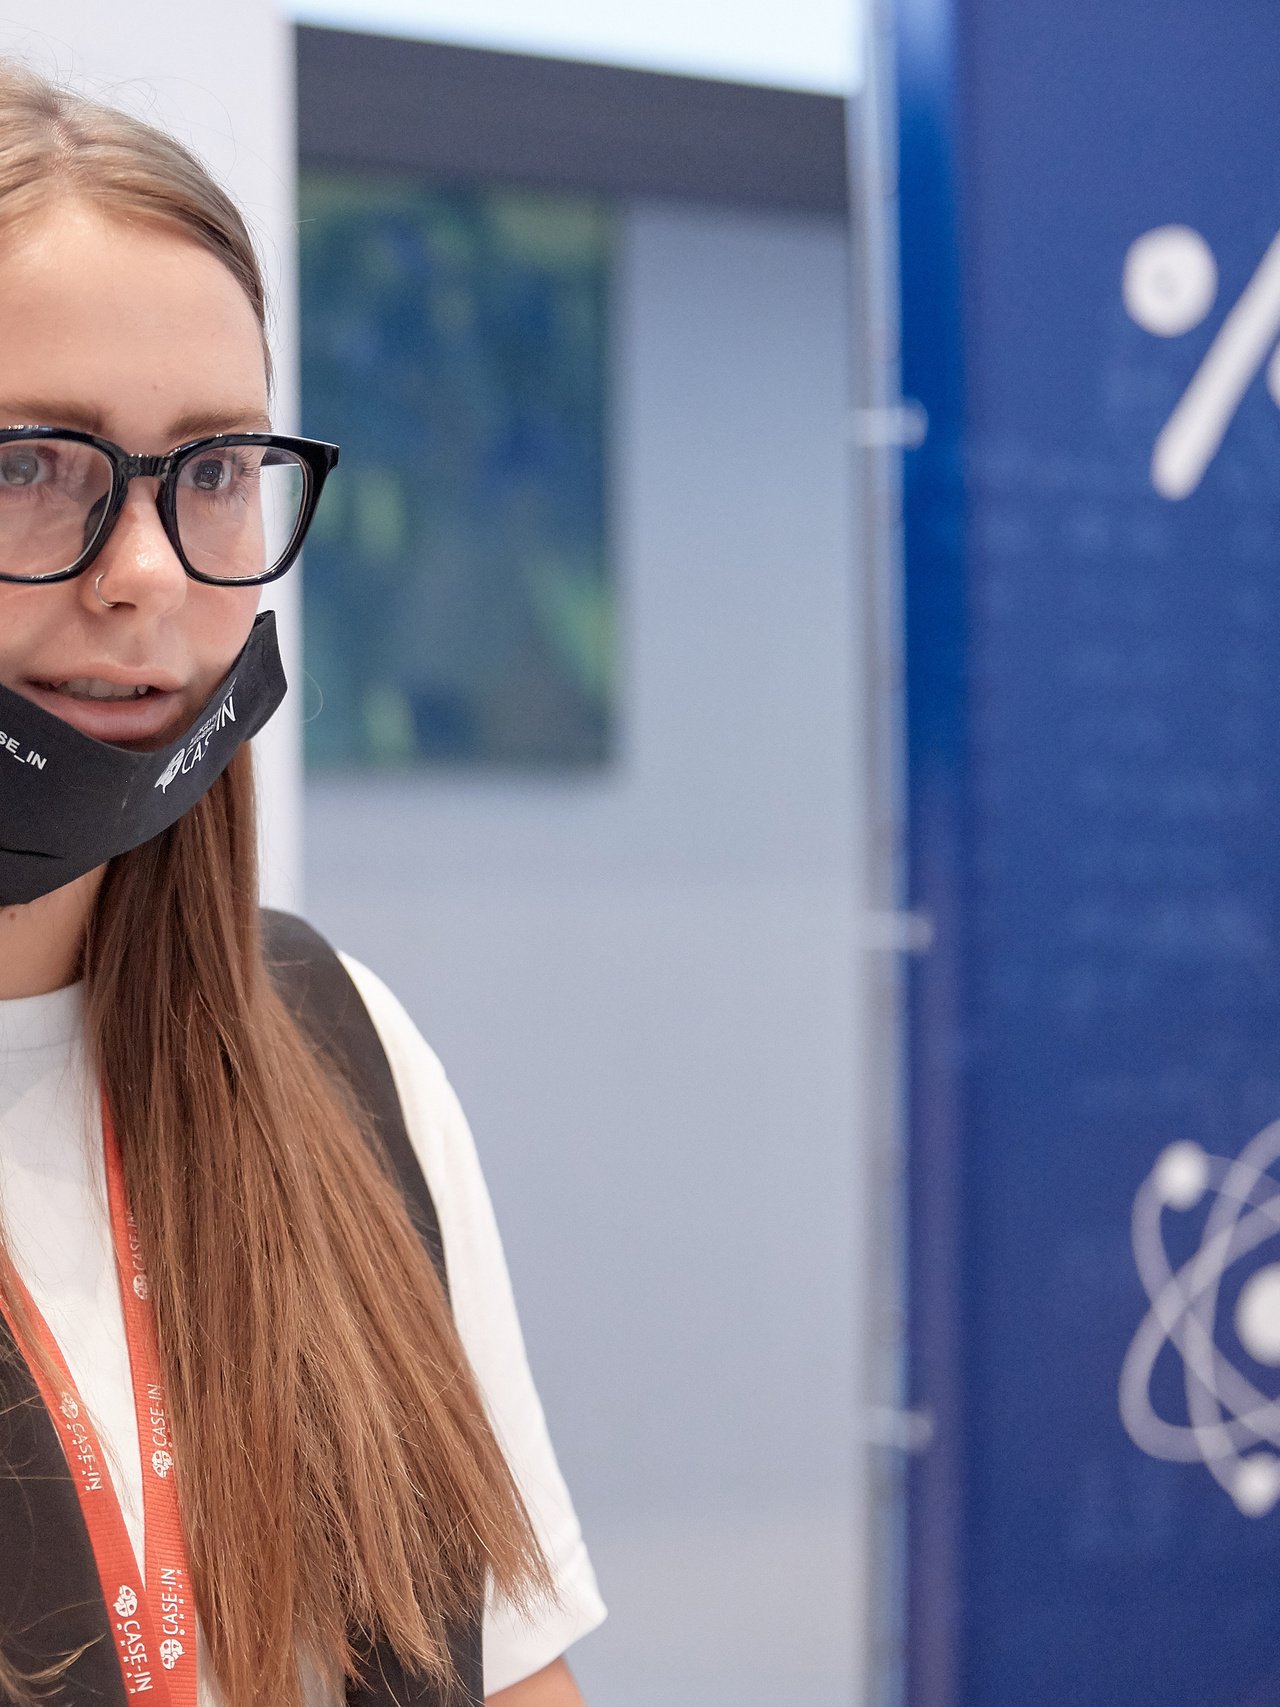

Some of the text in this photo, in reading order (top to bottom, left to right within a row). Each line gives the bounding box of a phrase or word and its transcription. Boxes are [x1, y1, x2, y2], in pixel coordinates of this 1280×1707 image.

[147, 1383, 167, 1447] CASE-IN
[72, 1423, 103, 1491] CASE-IN
[161, 1568, 179, 1635] CASE-IN
[123, 1620, 154, 1692] CASE-IN
